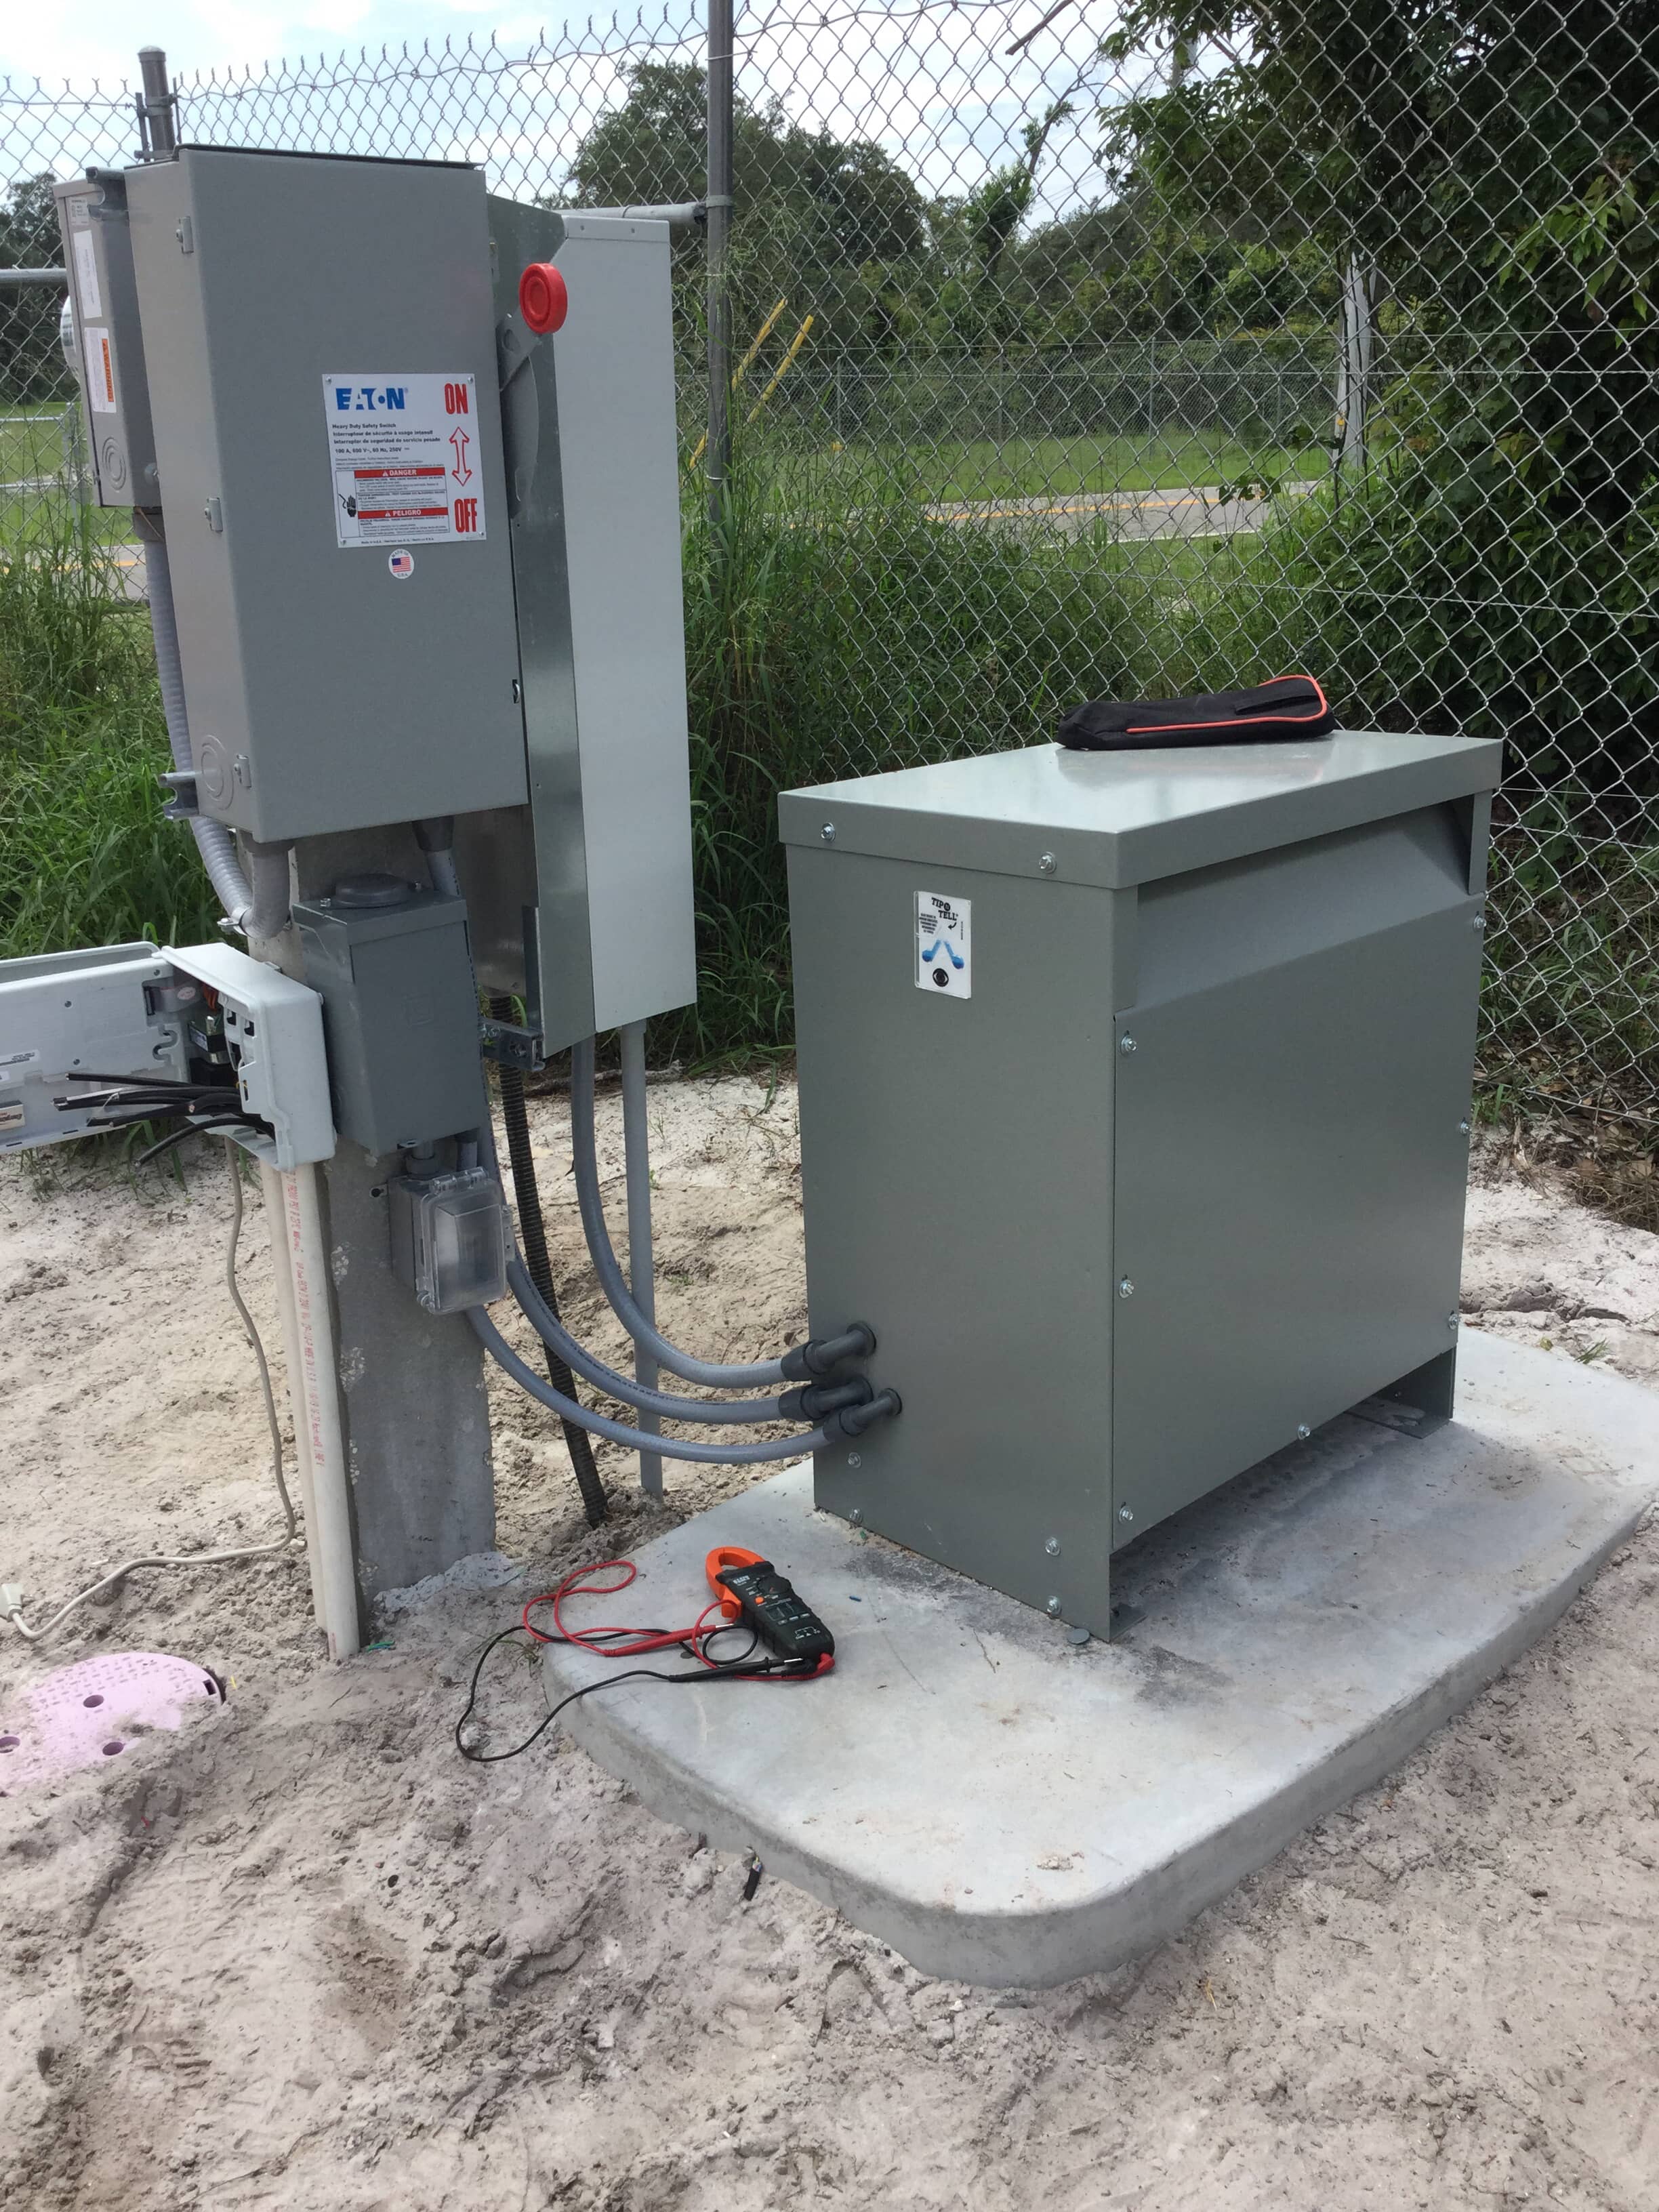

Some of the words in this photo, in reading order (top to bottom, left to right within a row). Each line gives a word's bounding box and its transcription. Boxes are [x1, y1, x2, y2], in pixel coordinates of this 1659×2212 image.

[335, 388, 405, 410] EATON
[444, 382, 468, 415] ON
[454, 498, 478, 533] OFF
[938, 910, 957, 921] TELL
